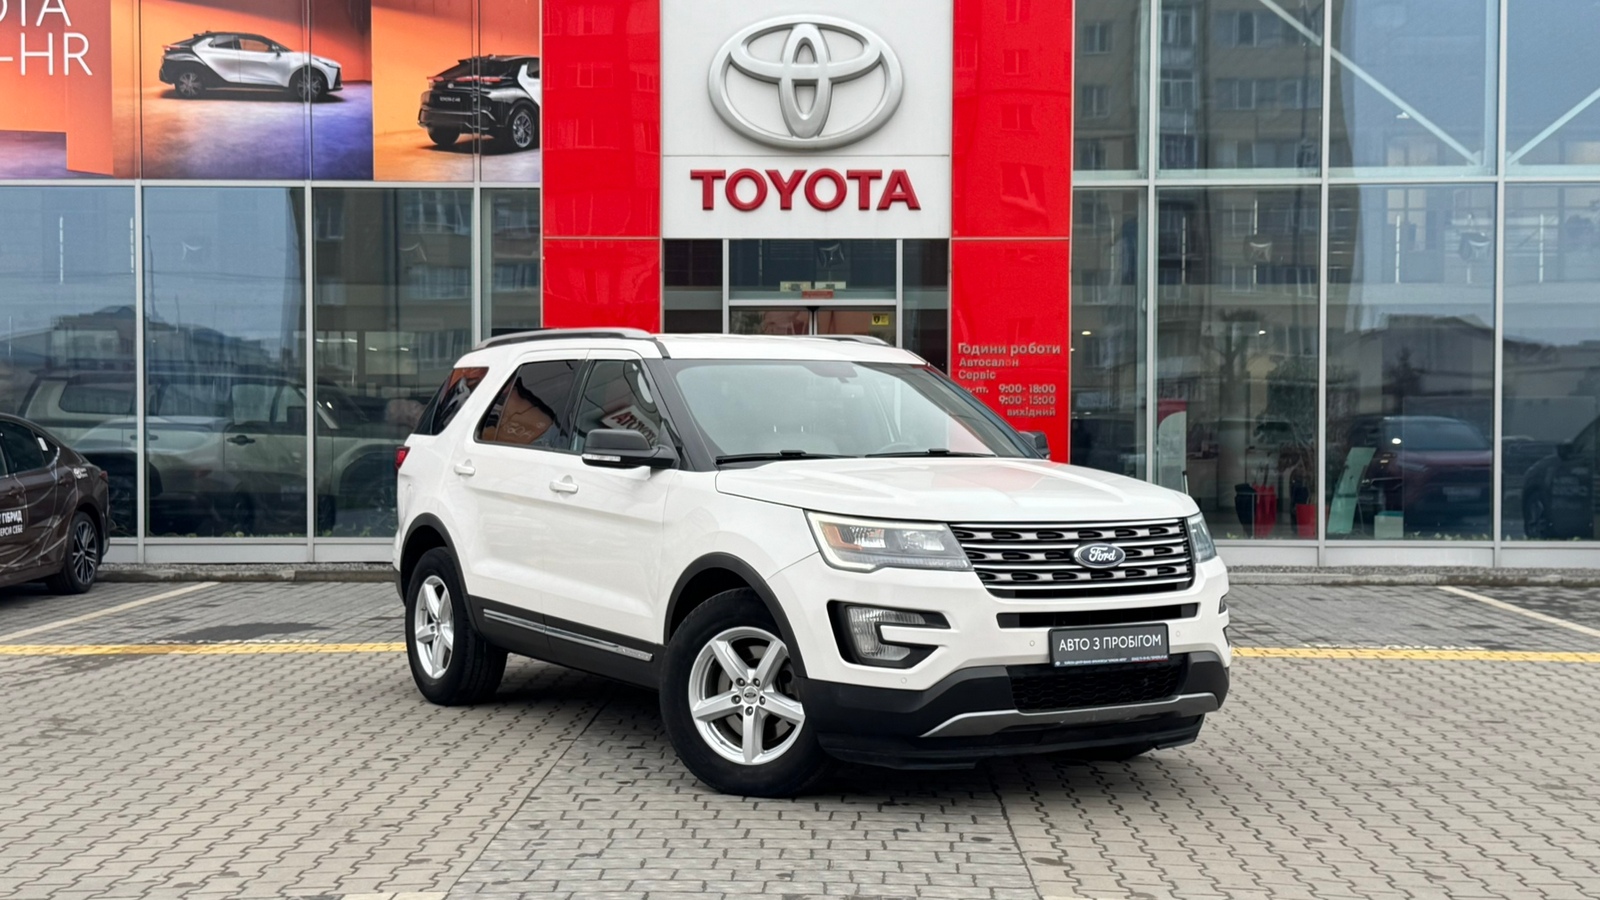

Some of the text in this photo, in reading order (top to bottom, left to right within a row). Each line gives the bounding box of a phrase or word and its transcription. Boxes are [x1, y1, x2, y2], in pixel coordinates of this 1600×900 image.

[690, 168, 922, 212] TOYOTA
[957, 342, 1061, 357] Години роботи
[959, 358, 1019, 367] Автосалон
[958, 370, 997, 381] Сервіс
[1007, 407, 1056, 418] вихідний
[1089, 546, 1116, 562] Ford
[1059, 634, 1162, 652] АВТО З ПРОБІГОМ
